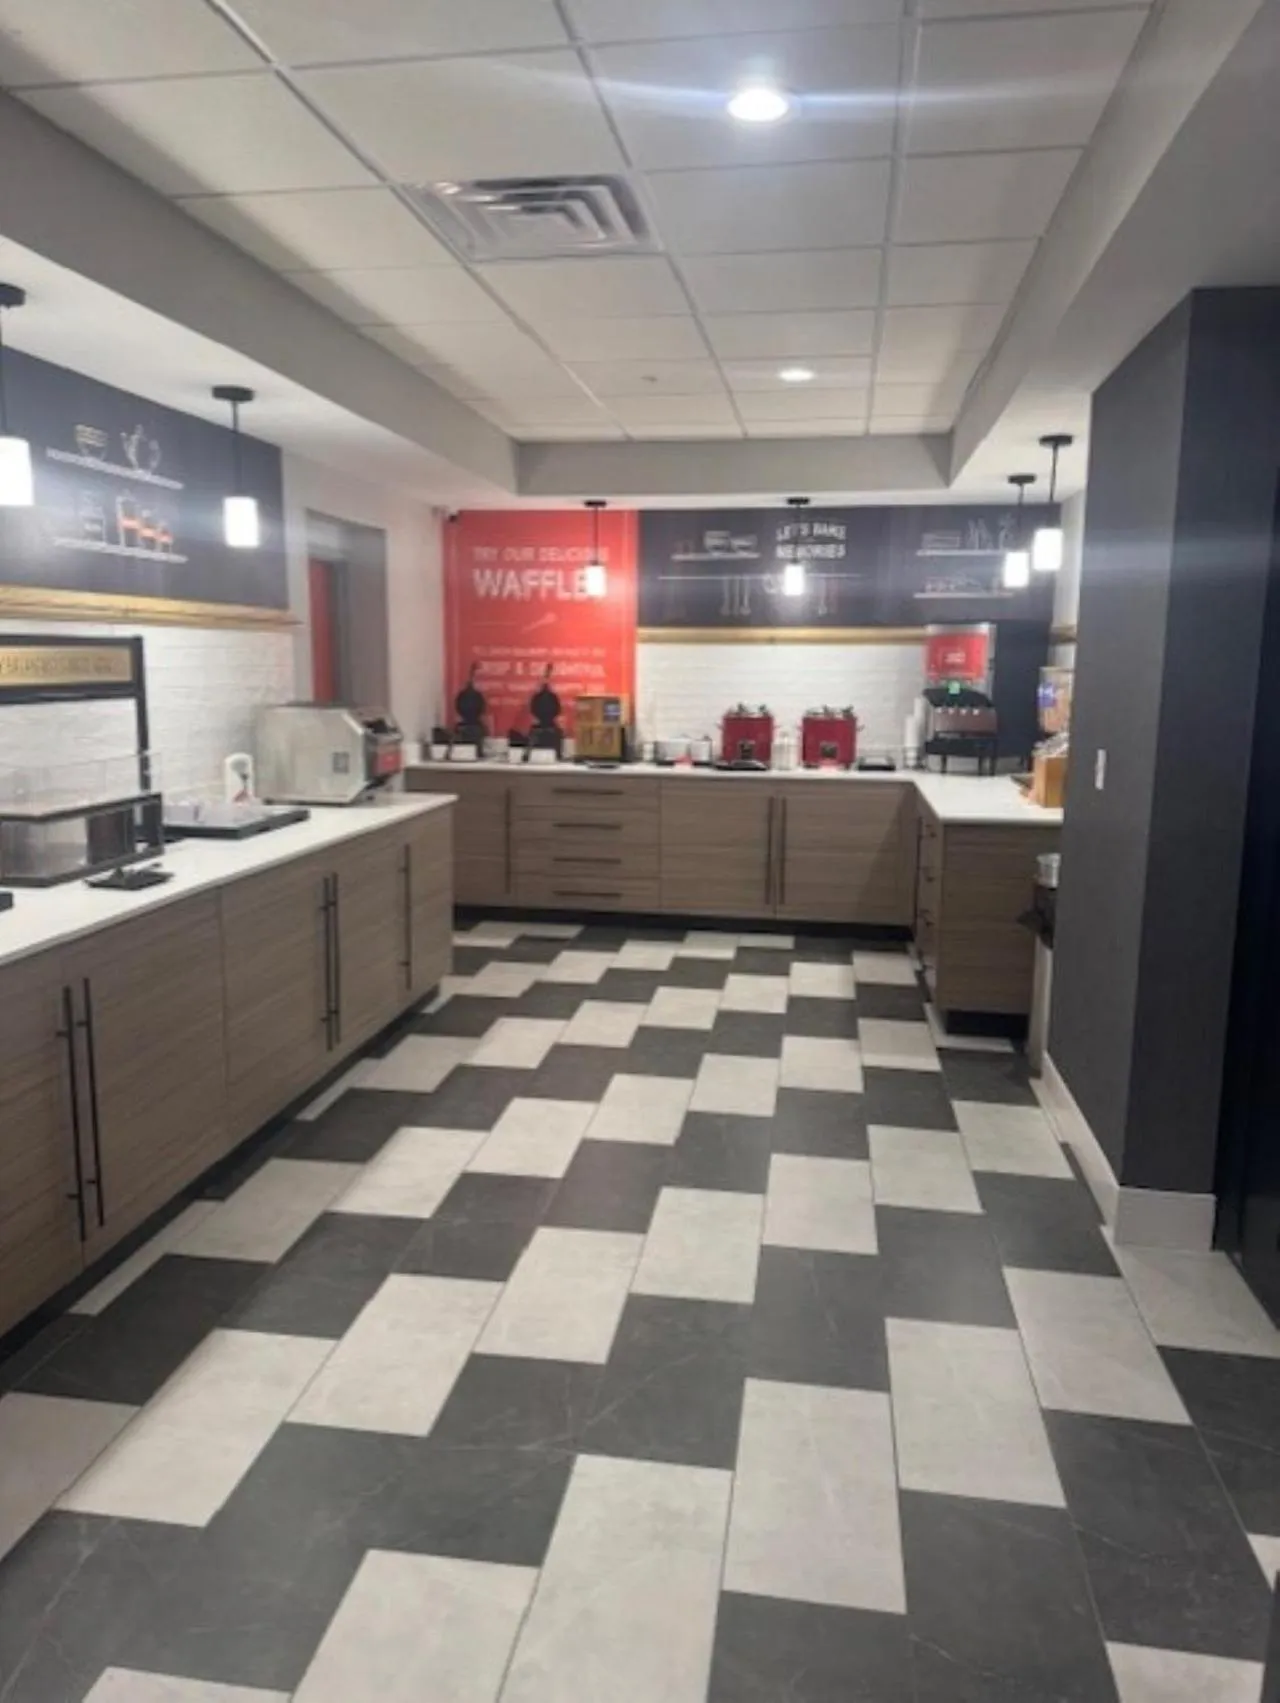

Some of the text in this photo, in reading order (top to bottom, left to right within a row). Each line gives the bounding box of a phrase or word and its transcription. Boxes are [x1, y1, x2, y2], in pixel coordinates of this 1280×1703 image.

[473, 547, 498, 561] TRY
[502, 547, 534, 561] OUR
[472, 568, 607, 601] WAFFLE
